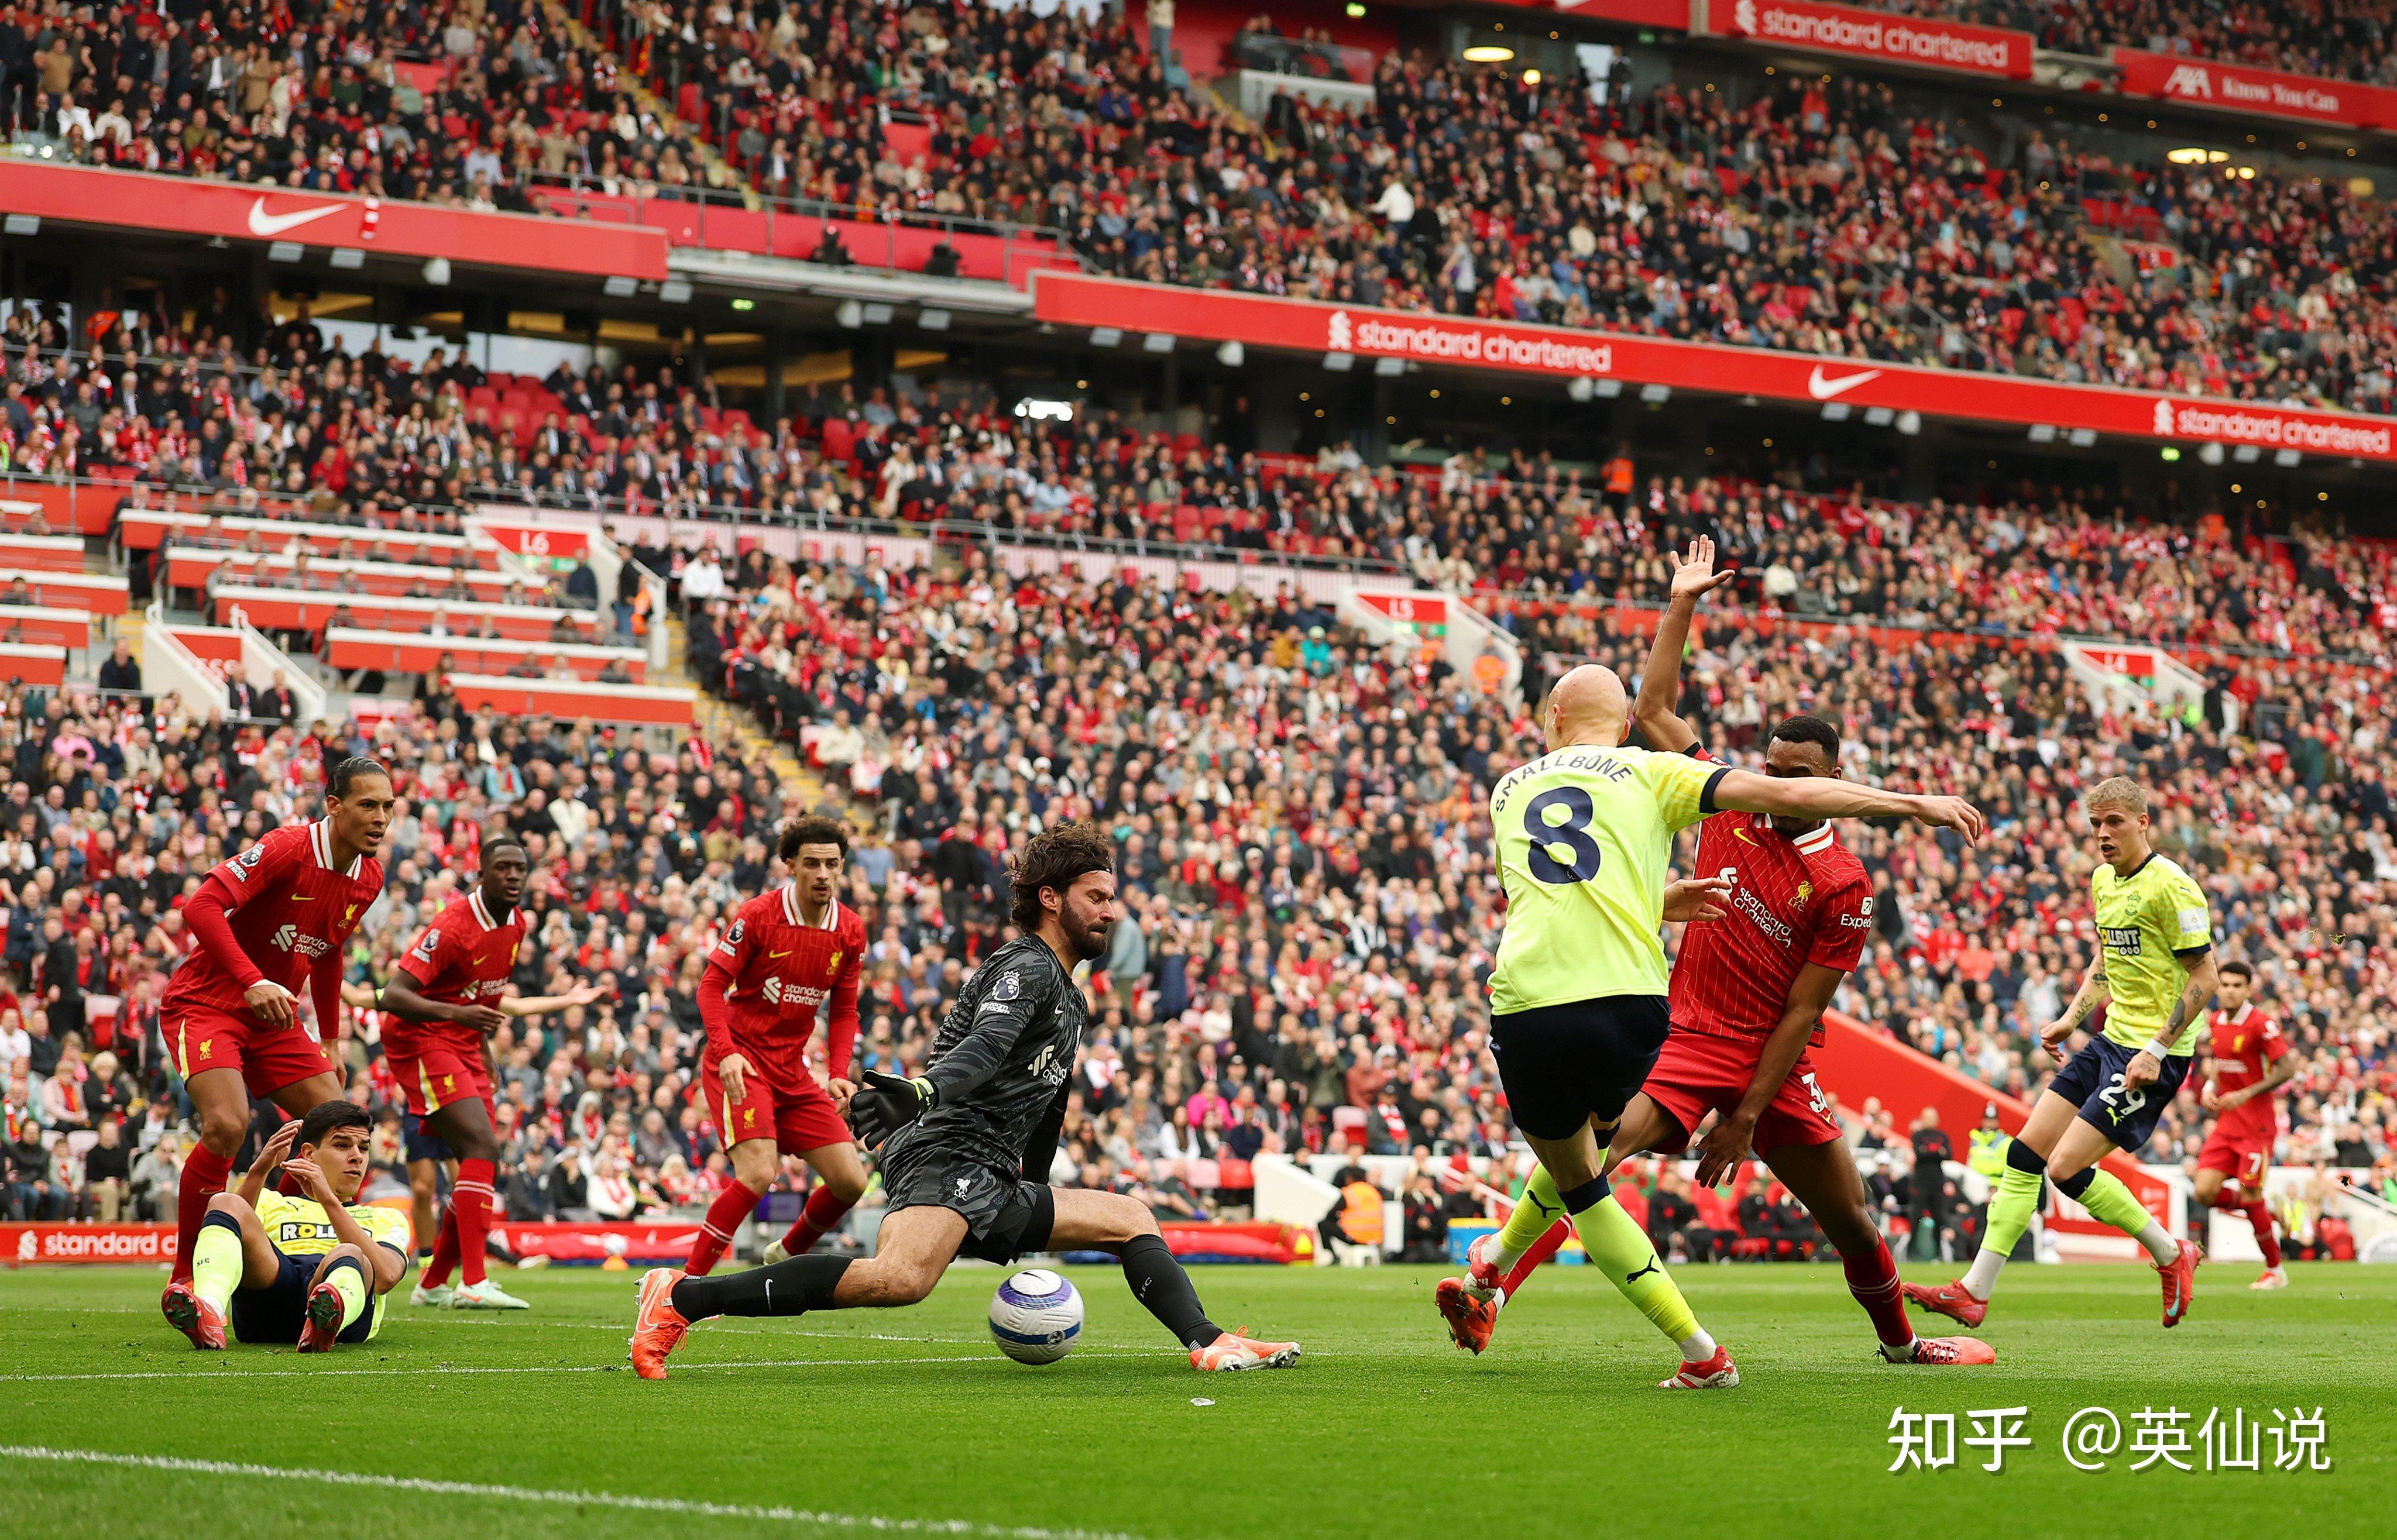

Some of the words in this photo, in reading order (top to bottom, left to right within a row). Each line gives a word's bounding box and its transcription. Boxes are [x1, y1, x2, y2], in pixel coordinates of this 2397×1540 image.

[1763, 8, 1883, 50] standard
[1884, 26, 2008, 67] chartered
[2164, 64, 2212, 99] AXA
[1358, 320, 1482, 359] standard
[1483, 336, 1612, 373] chartered
[2178, 407, 2282, 442] standard
[2282, 418, 2391, 454] chartered
[520, 530, 550, 555] L6
[1496, 755, 1632, 812] SMALLBONE
[1524, 786, 1601, 884] 8
[2101, 929, 2138, 946] OLLBIT
[2099, 1072, 2146, 1116] 29
[2248, 1152, 2262, 1175] 7
[44, 1230, 159, 1256] standard
[283, 1223, 338, 1240] ROLL
